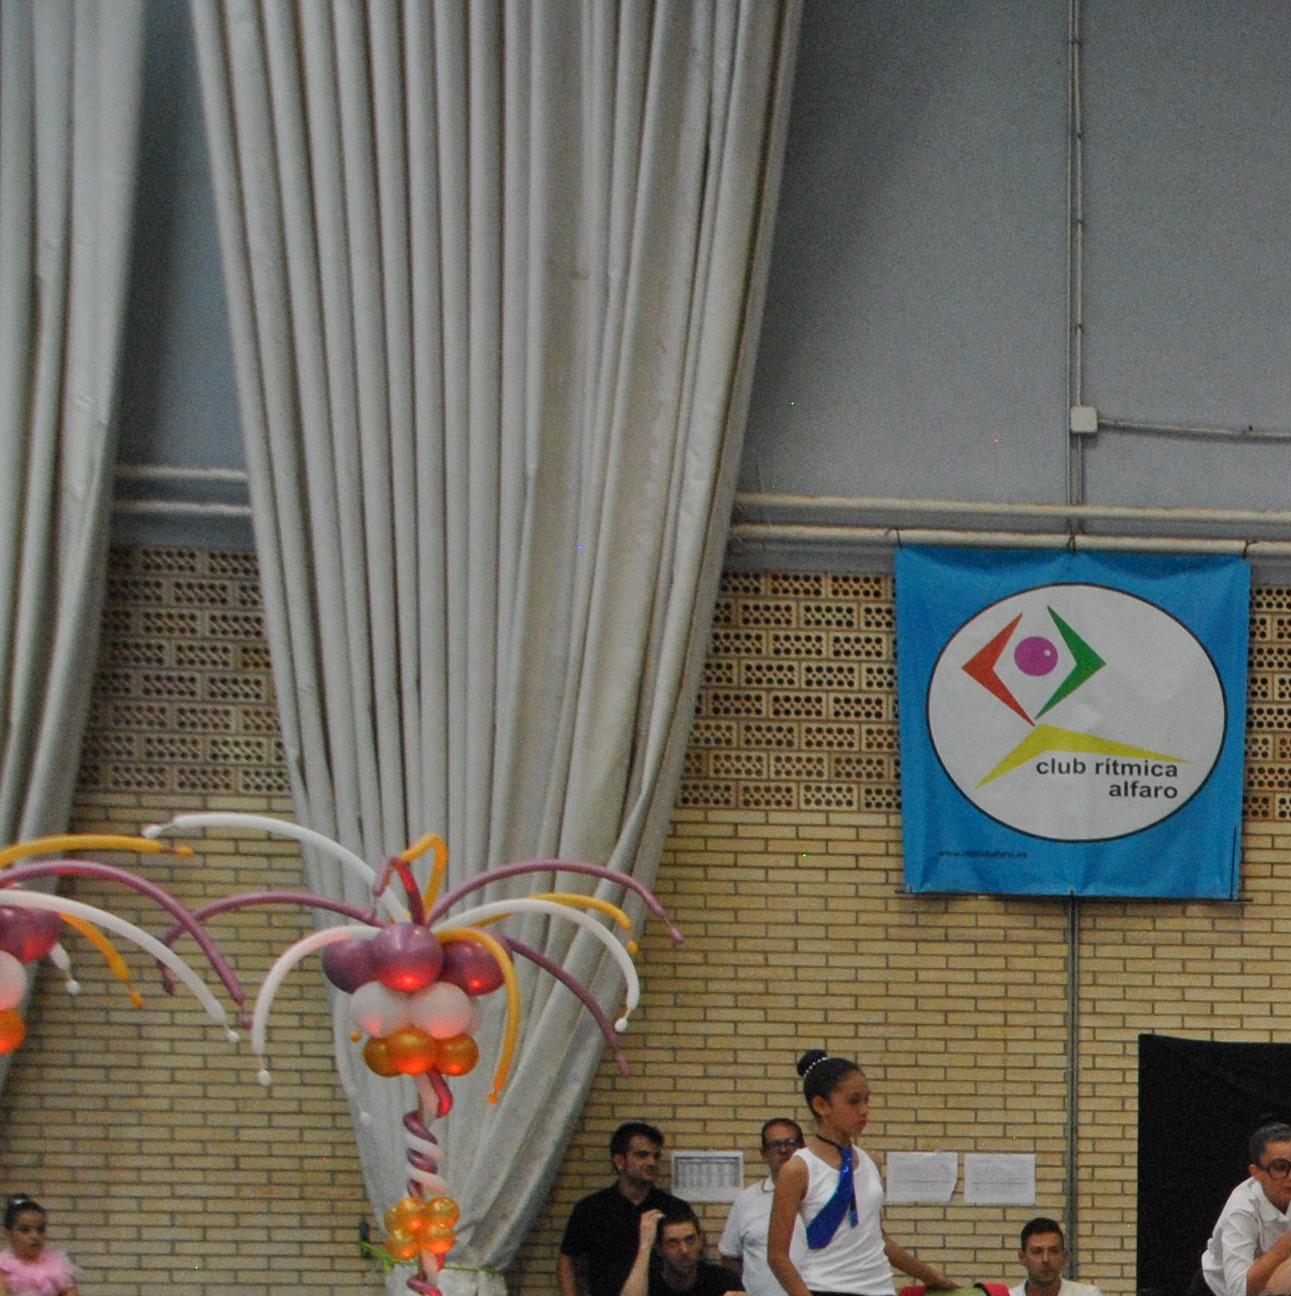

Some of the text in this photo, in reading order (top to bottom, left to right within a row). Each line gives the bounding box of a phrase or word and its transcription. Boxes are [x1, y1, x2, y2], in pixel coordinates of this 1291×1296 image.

[1036, 758, 1178, 778] club rítmica
[1108, 781, 1178, 799] alfaro
